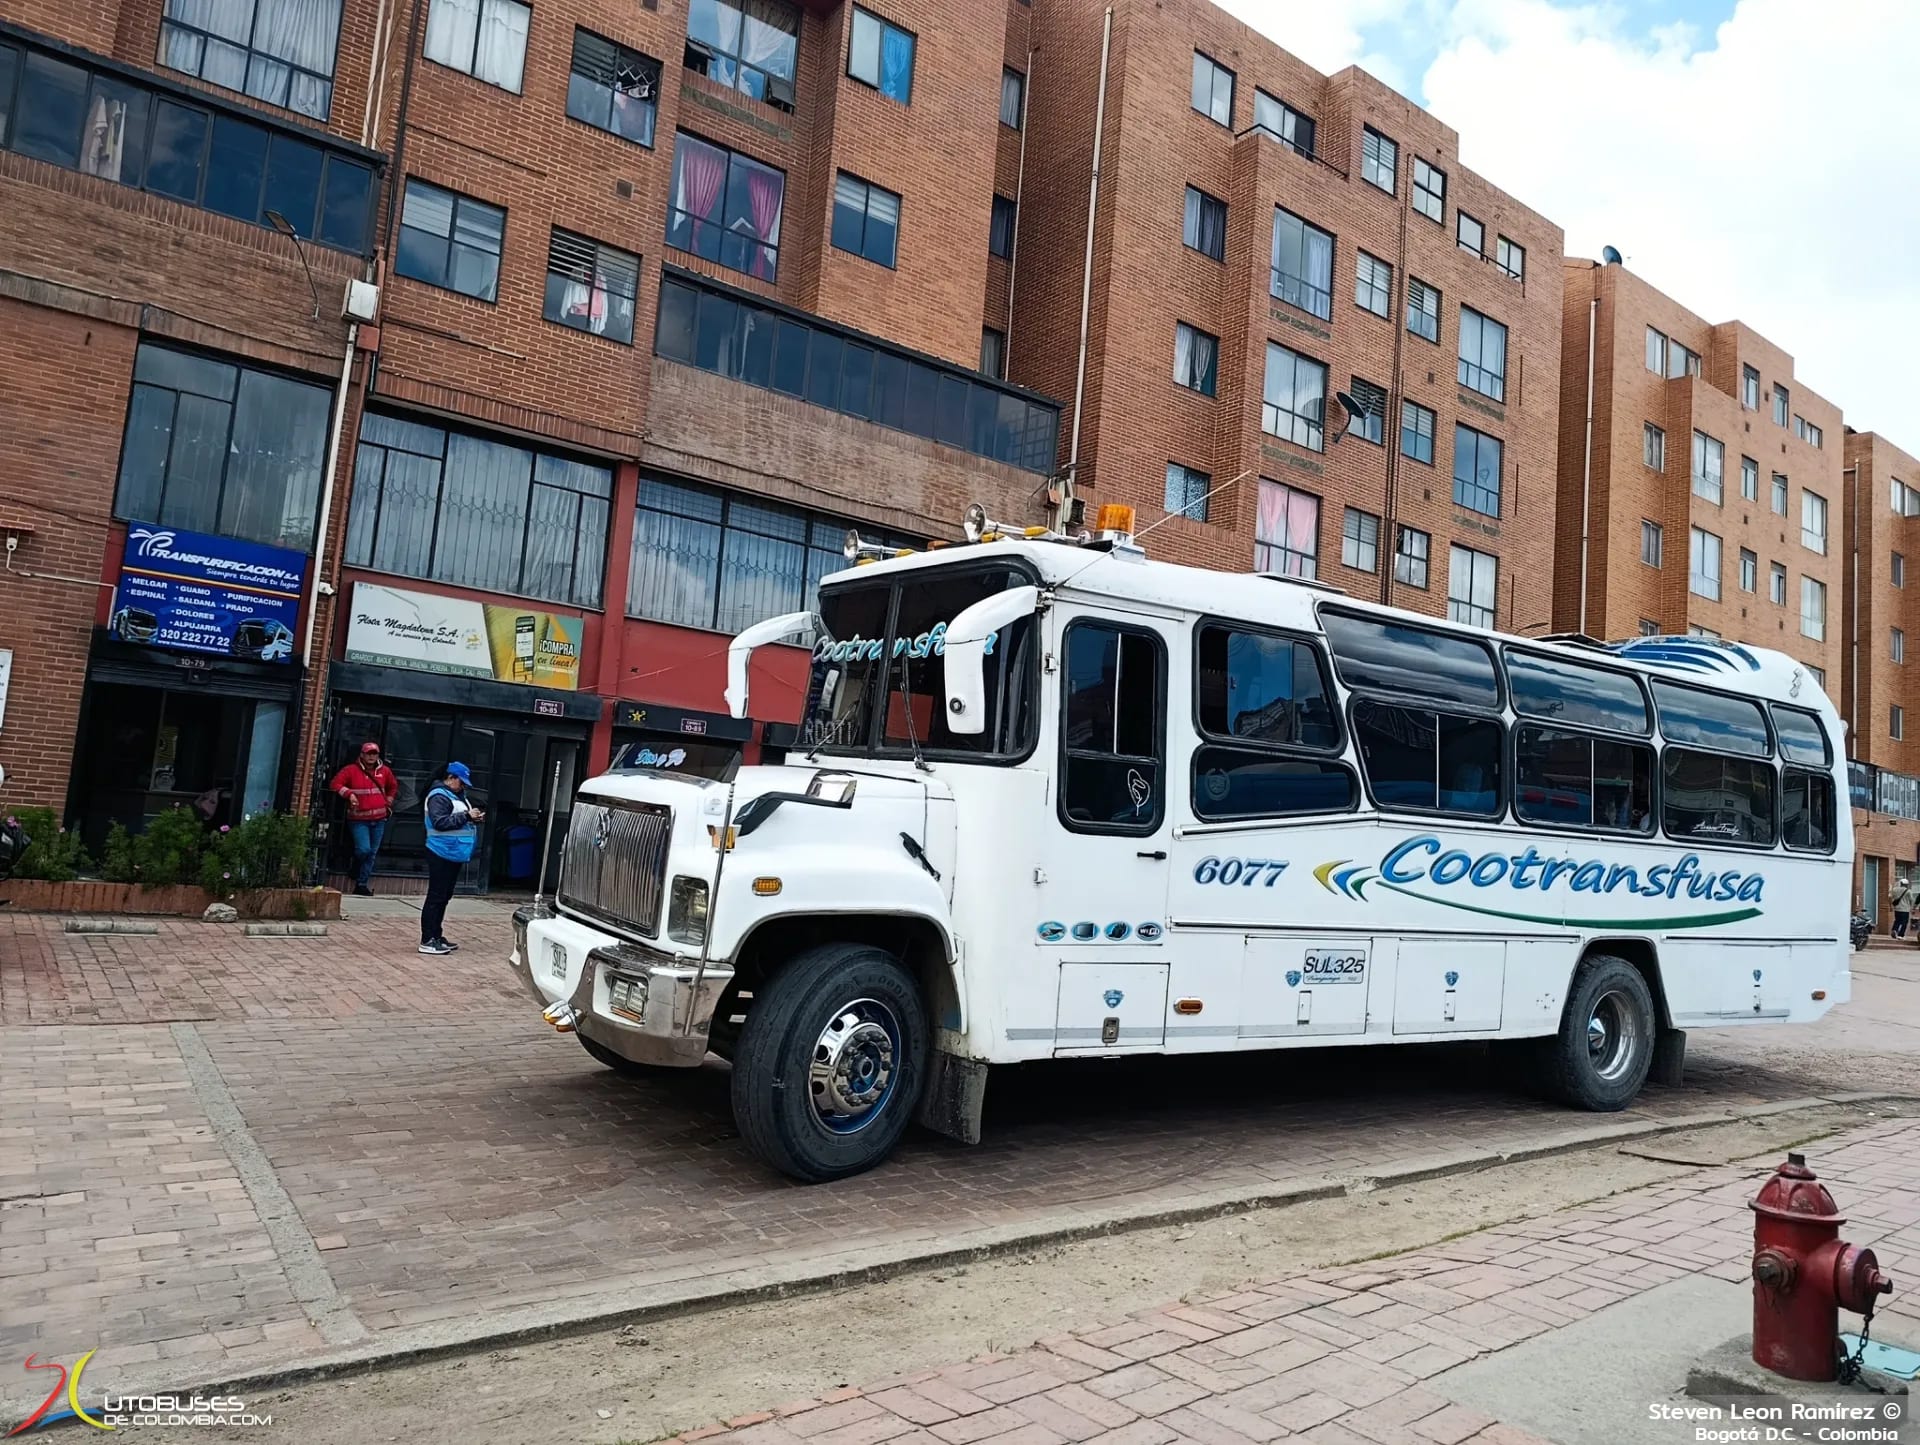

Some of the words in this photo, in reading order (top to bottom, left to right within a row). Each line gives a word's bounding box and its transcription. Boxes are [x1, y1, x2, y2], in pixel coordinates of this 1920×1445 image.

[151, 548, 285, 578] TRANSPURIFICACION
[132, 577, 168, 589] MELGAR
[206, 567, 238, 579] Siempre
[280, 579, 300, 590] lugar
[130, 588, 167, 600] ESPINAL
[180, 585, 211, 596] GUAMO
[227, 592, 283, 607] PURIFICACION
[175, 608, 215, 620] DOLORES
[225, 603, 254, 613] PRADO
[173, 620, 222, 633] ALPUJARRA
[357, 613, 381, 627] Flota
[384, 617, 434, 636] Magdalena
[437, 627, 459, 639] S.A.
[160, 628, 180, 640] 320
[181, 632, 201, 644] 222
[202, 635, 215, 645] 77
[216, 636, 230, 647] 22
[181, 657, 206, 668] 10-79
[537, 656, 547, 664] en
[1192, 855, 1290, 887] 6077
[1379, 833, 1765, 903] Cootransfusa
[1303, 956, 1366, 974] SUL325
